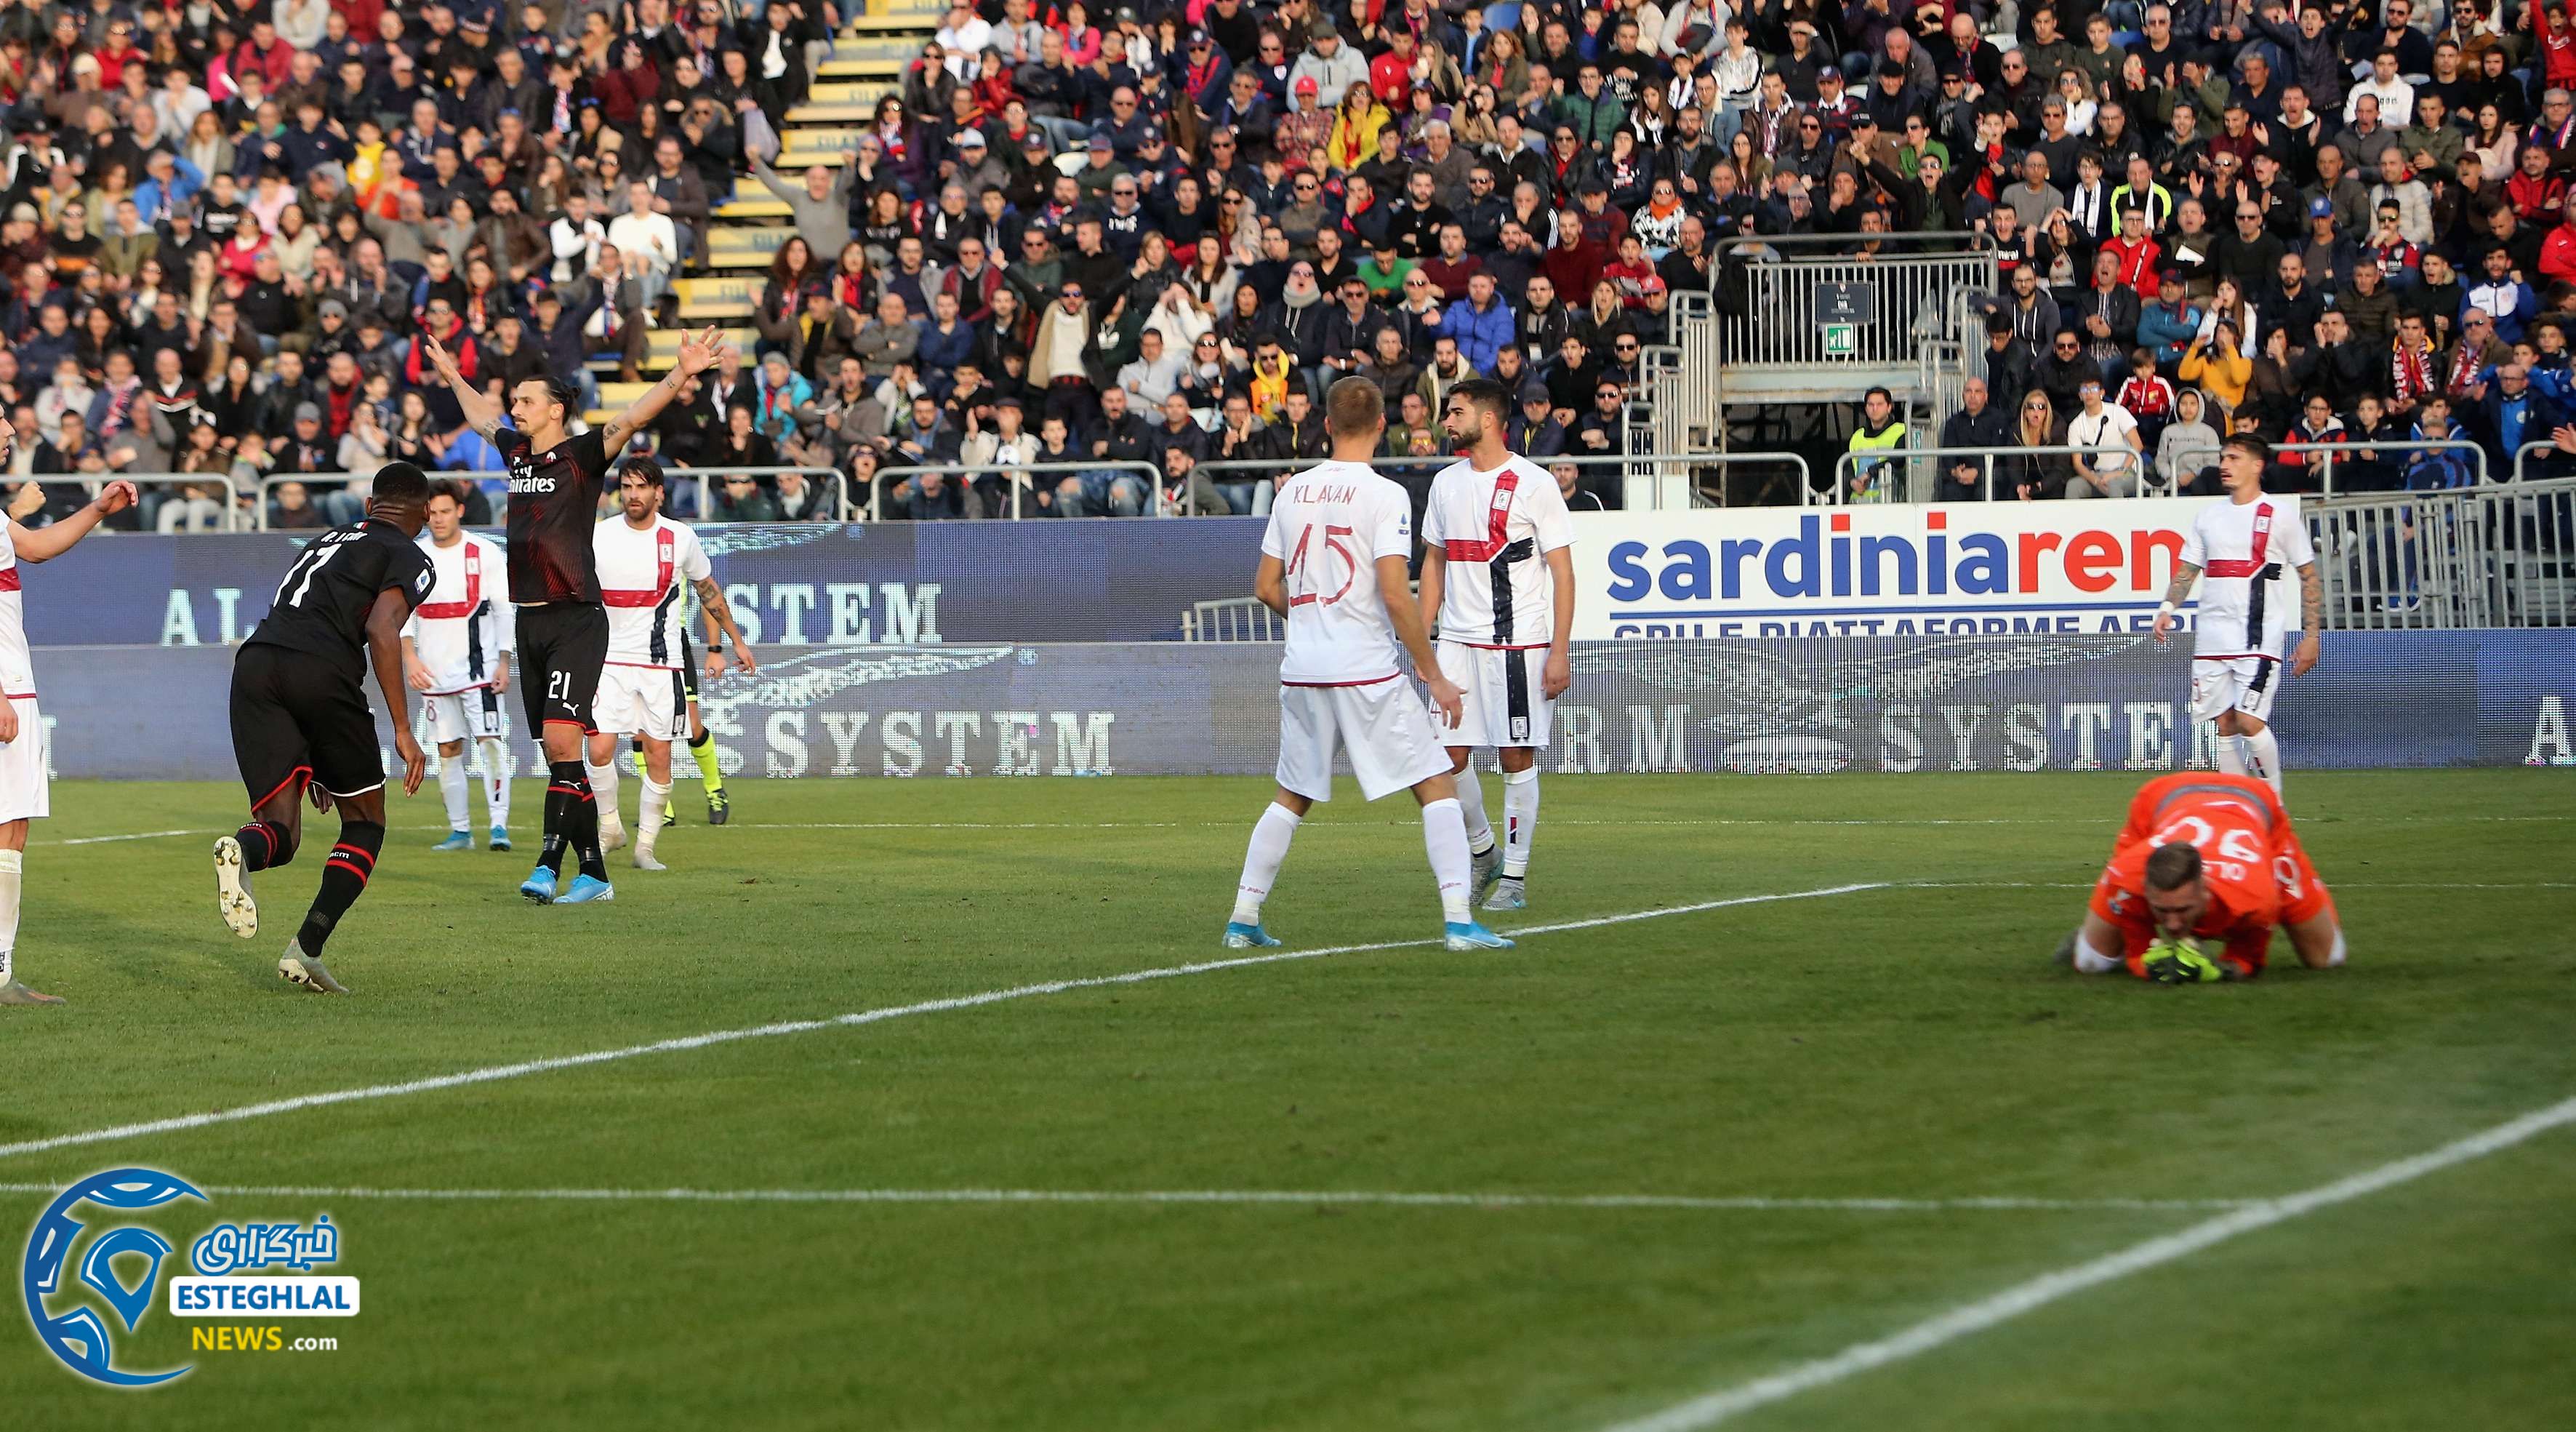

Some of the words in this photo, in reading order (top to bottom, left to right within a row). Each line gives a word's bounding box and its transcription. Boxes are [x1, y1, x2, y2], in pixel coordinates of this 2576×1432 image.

[1293, 484, 1357, 505] KLAVAN
[1288, 523, 1355, 608] 15
[1607, 511, 2186, 602] sardiniaren
[685, 583, 942, 646] STEM
[547, 670, 571, 700] 21
[766, 711, 1115, 778] SYSTEM
